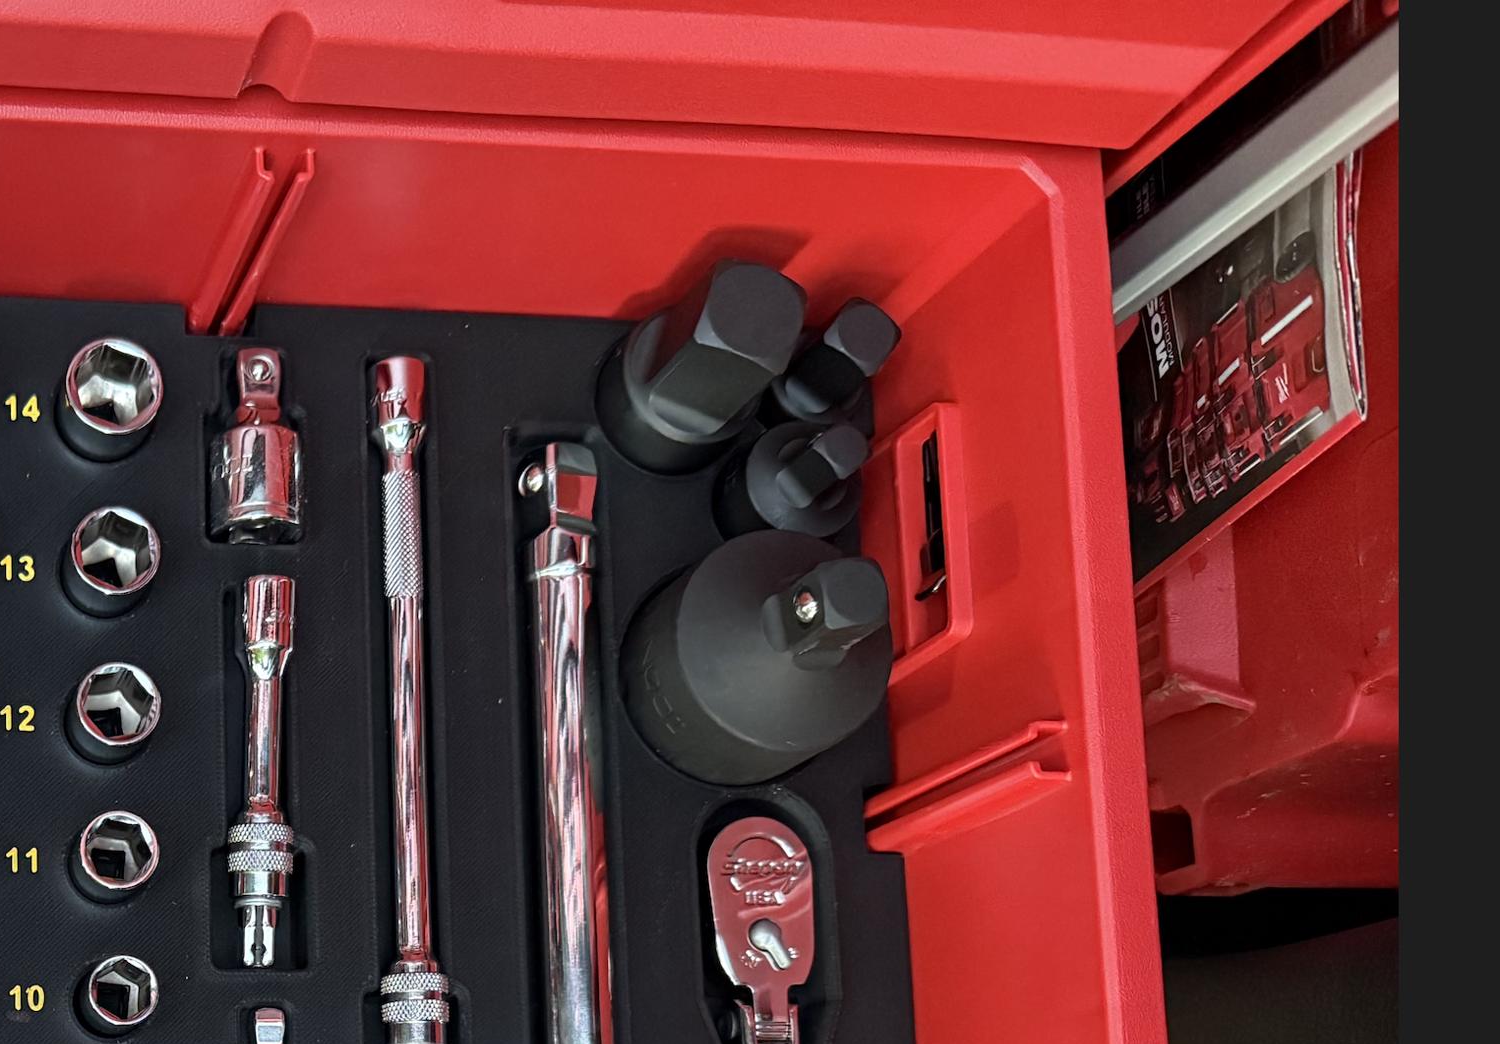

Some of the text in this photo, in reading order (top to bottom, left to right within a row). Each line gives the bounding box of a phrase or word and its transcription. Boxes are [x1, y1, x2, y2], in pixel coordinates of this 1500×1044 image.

[4, 394, 41, 423] 14
[0, 554, 36, 582] 13
[0, 704, 35, 732] 12
[5, 847, 39, 873] 11
[8, 984, 45, 1012] 10
